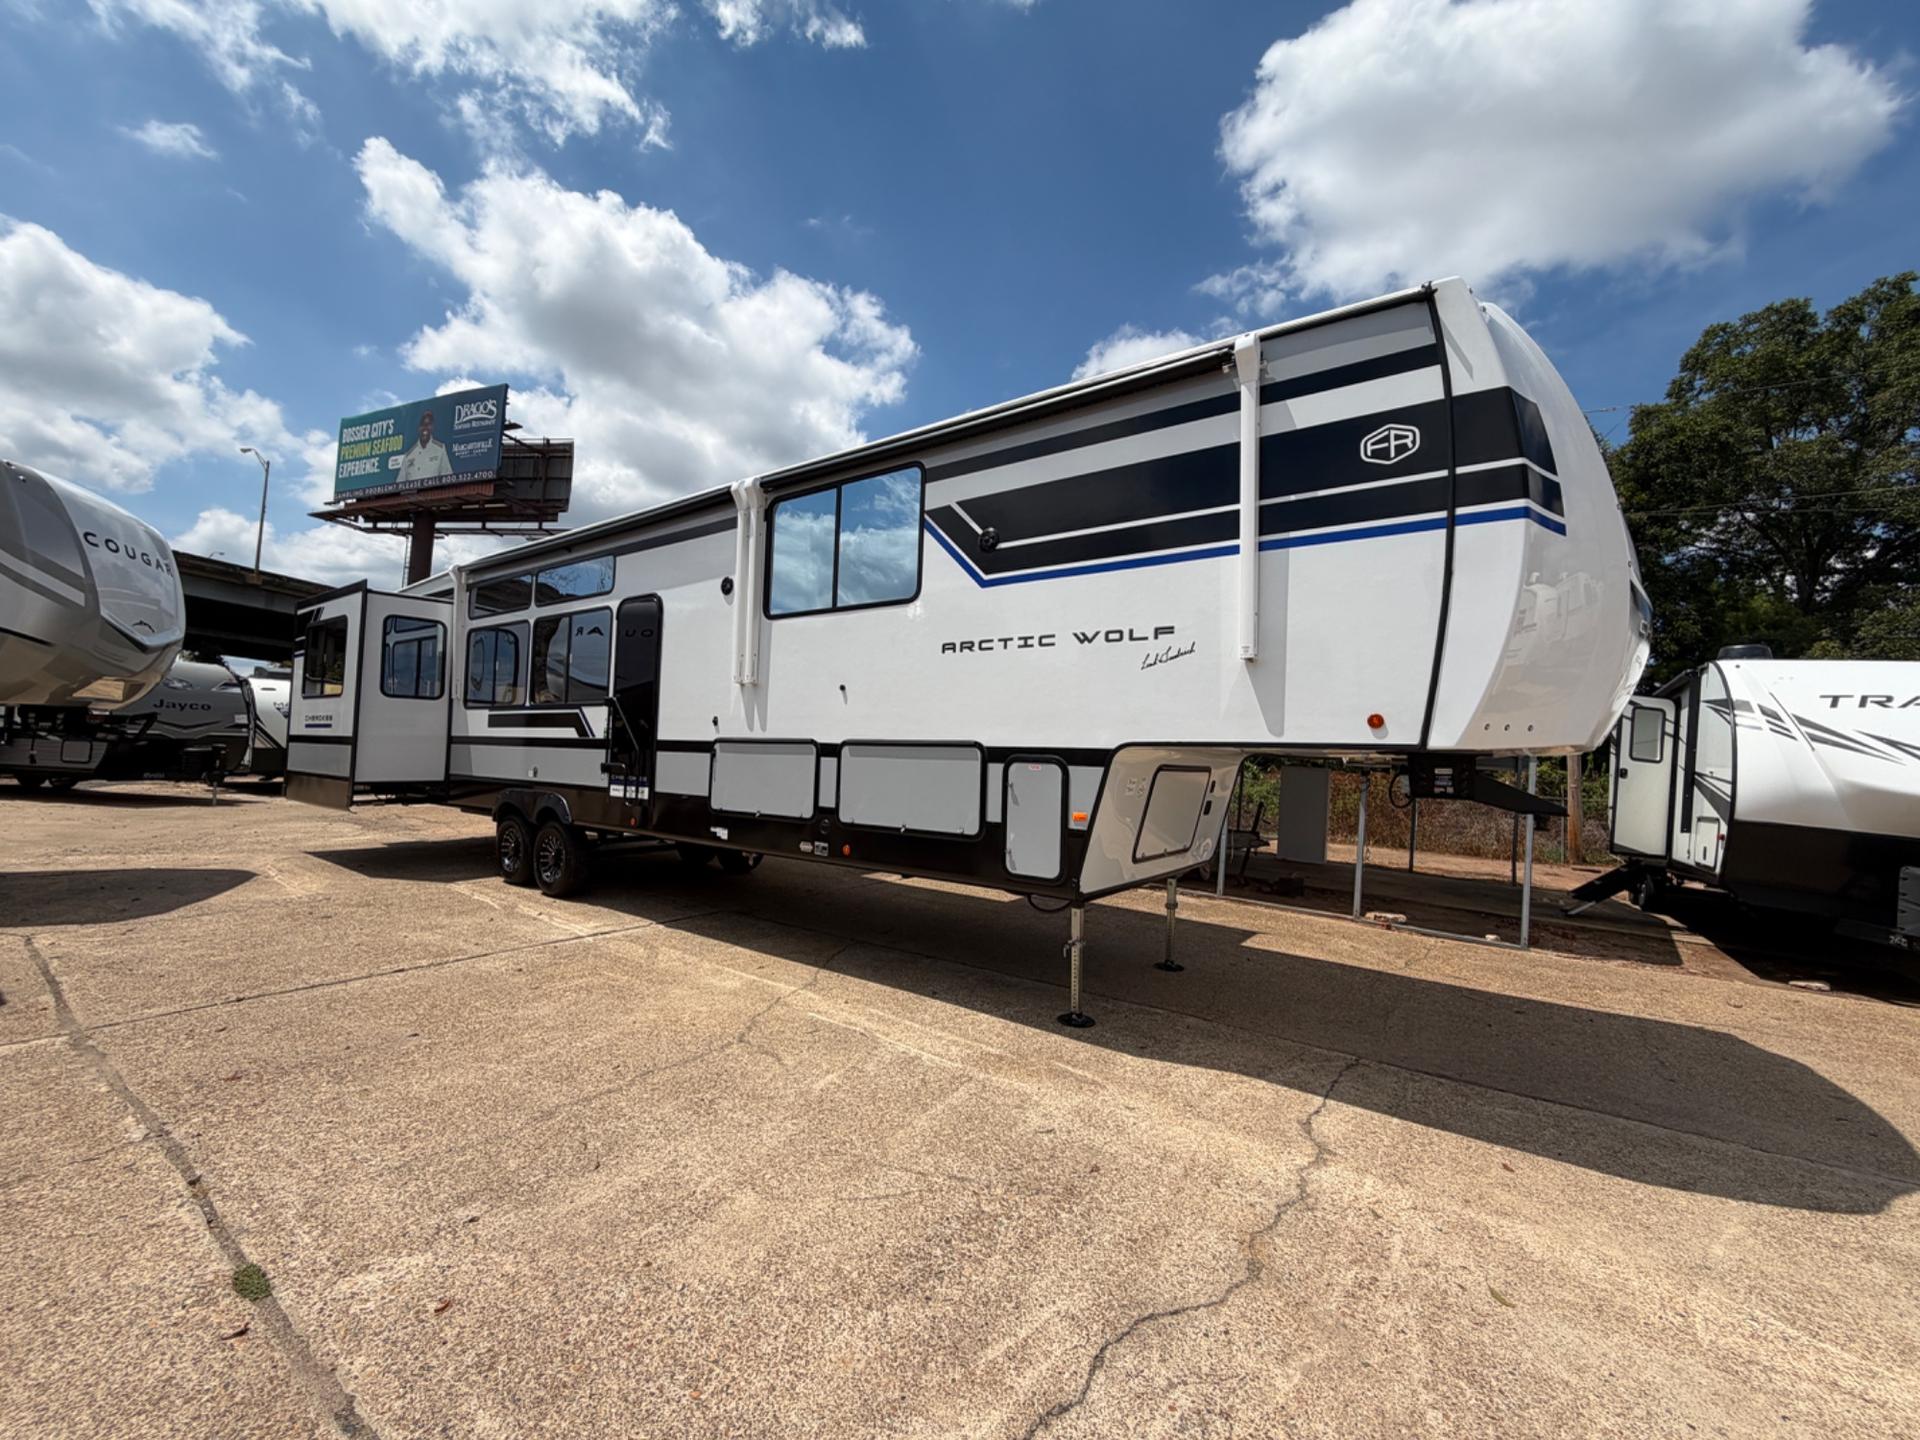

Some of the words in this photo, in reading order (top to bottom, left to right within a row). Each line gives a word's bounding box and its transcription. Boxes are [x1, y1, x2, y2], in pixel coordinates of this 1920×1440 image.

[456, 399, 497, 423] DRAGO'S
[343, 424, 370, 442] BOSSIER
[371, 419, 394, 436] CITY'S
[341, 442, 371, 461] PREMIUM
[373, 434, 403, 454] SEAFOOD
[399, 480, 420, 489] PLEASE
[83, 531, 174, 578] COUGAR
[941, 633, 1056, 654] ARCTIC
[1072, 625, 1175, 644] WOLF
[153, 699, 212, 712] Jayco
